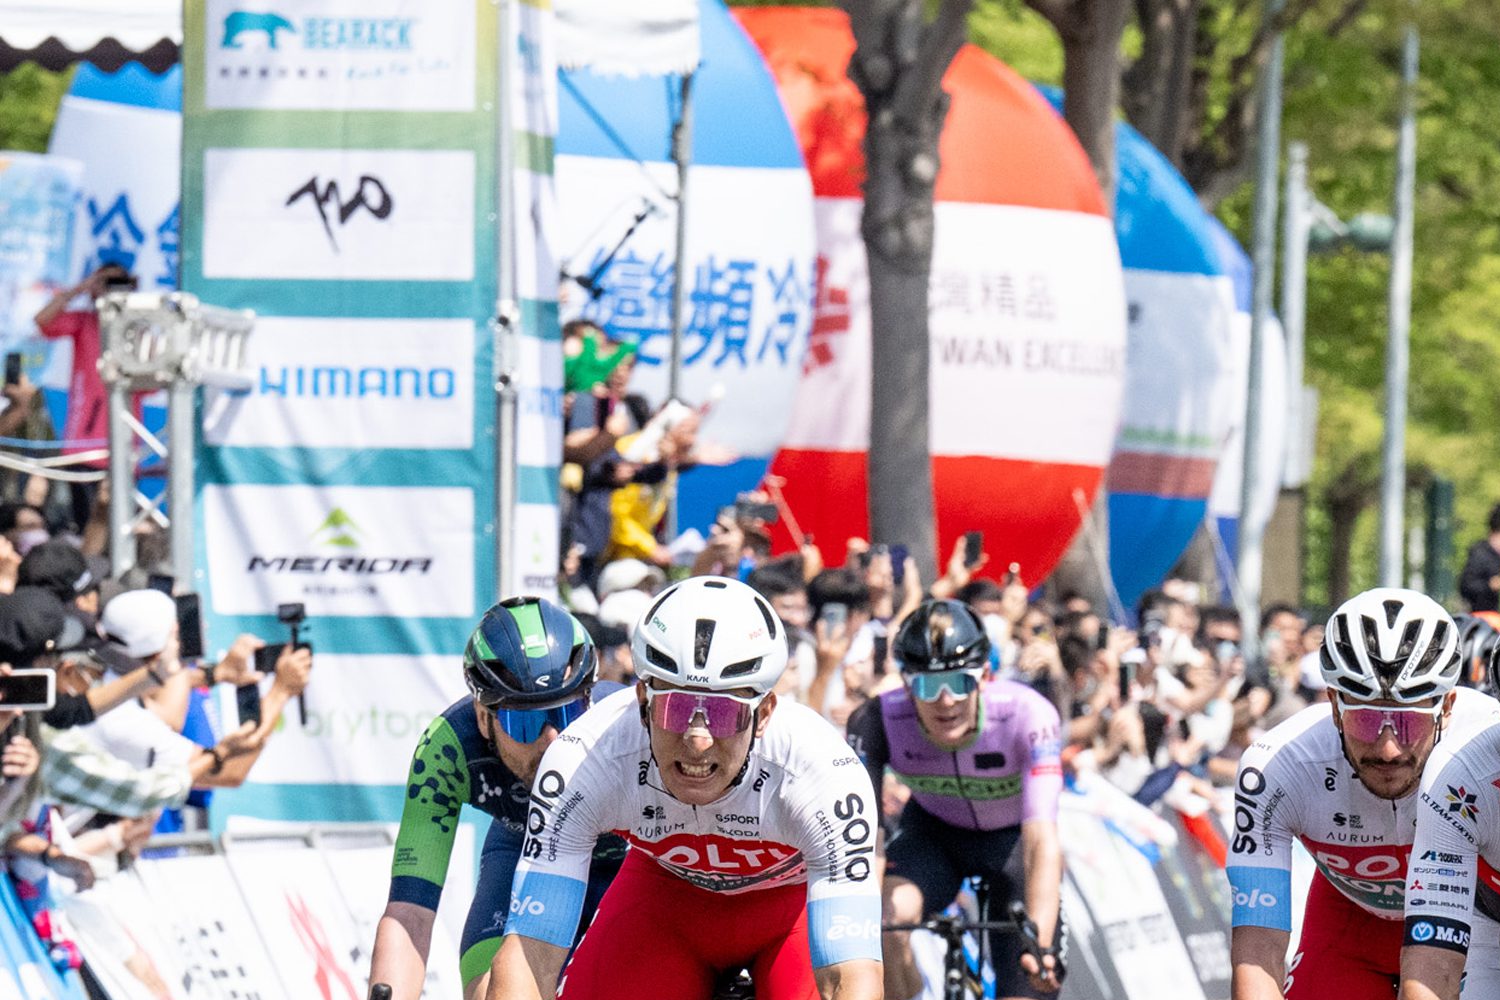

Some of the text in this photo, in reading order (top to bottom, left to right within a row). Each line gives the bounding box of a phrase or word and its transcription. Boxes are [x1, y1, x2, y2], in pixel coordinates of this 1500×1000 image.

[258, 366, 456, 400] HIMANO
[248, 556, 433, 575] MERIDA
[686, 673, 710, 684] KASK
[523, 769, 565, 860] solo
[715, 813, 760, 825] GSPORT
[1232, 766, 1266, 855] solo
[834, 792, 874, 883] solo
[1326, 831, 1384, 843] AURUM
[658, 843, 788, 869] OLTI
[510, 893, 545, 917] olo
[1434, 925, 1471, 948] MJS
